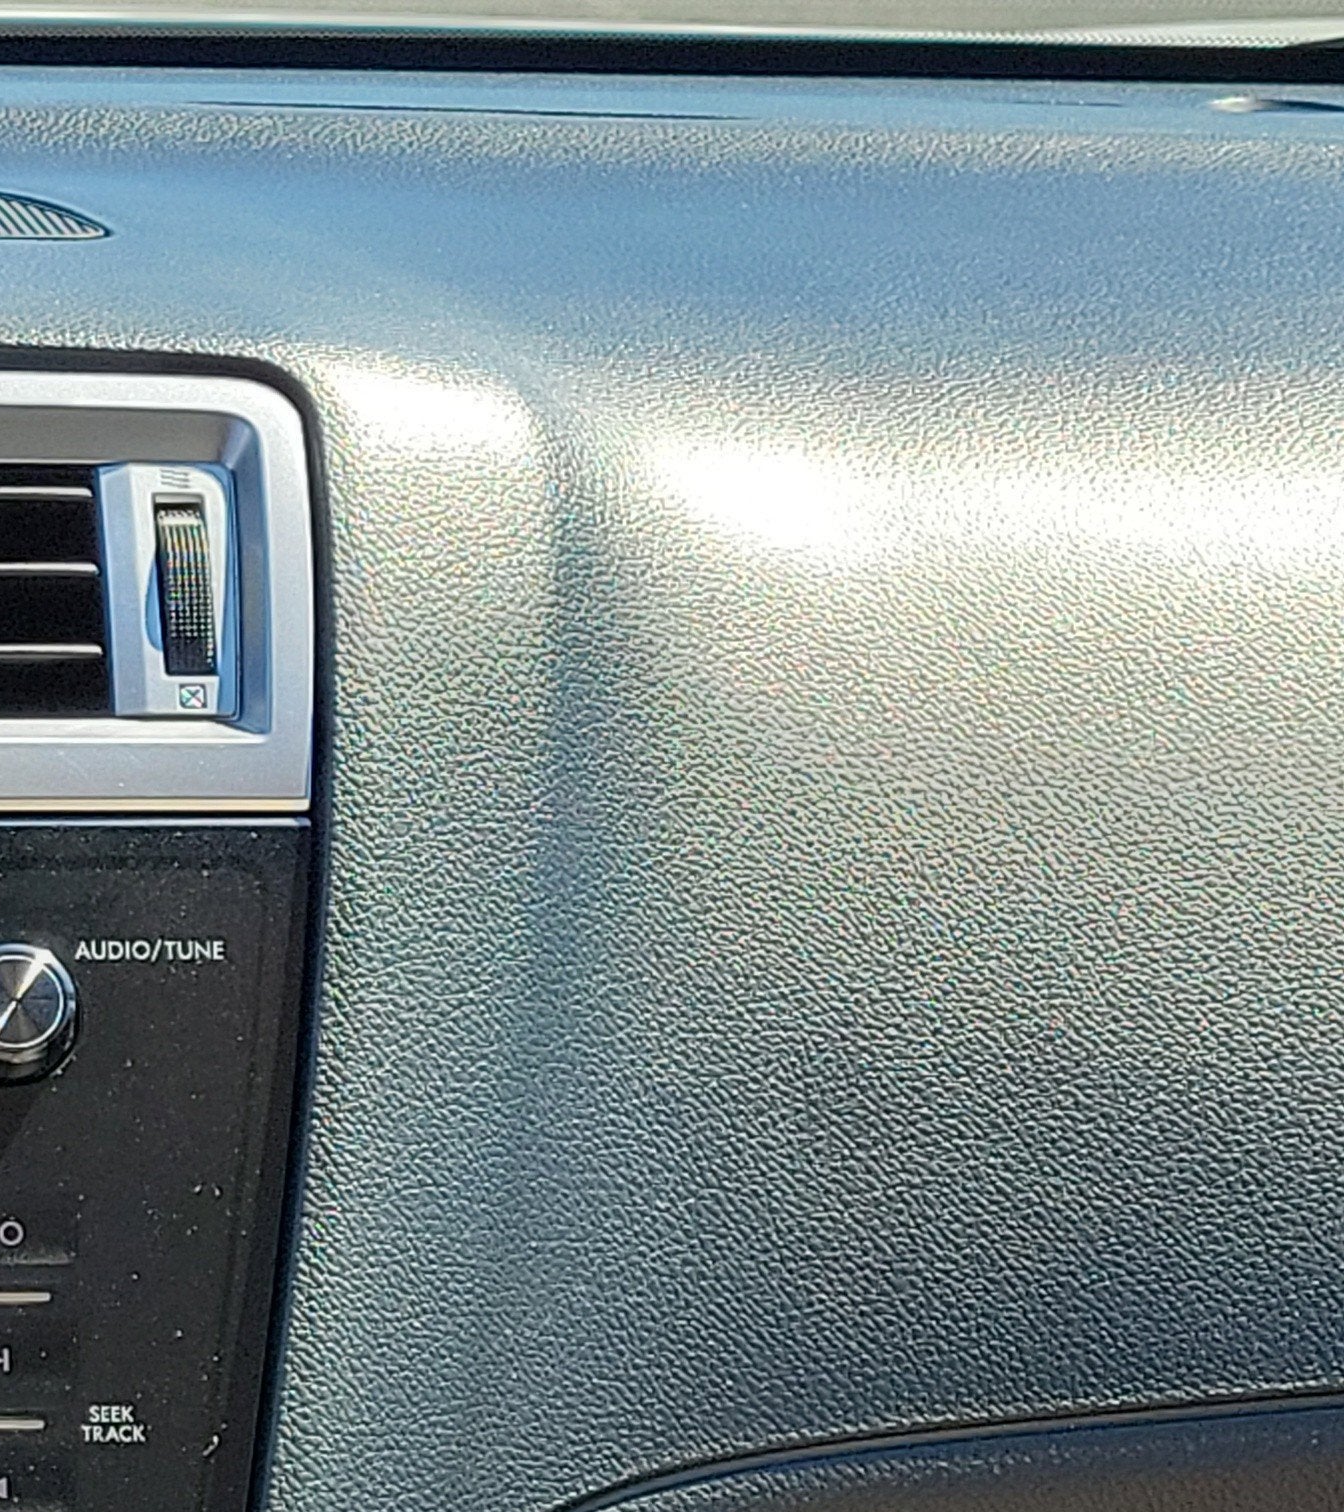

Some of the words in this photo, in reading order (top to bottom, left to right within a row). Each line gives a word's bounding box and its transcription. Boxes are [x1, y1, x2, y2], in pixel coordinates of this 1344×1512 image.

[74, 938, 224, 962] AUDIO/TUNE
[89, 1405, 134, 1423] SEEK
[81, 1424, 146, 1443] TRACK
